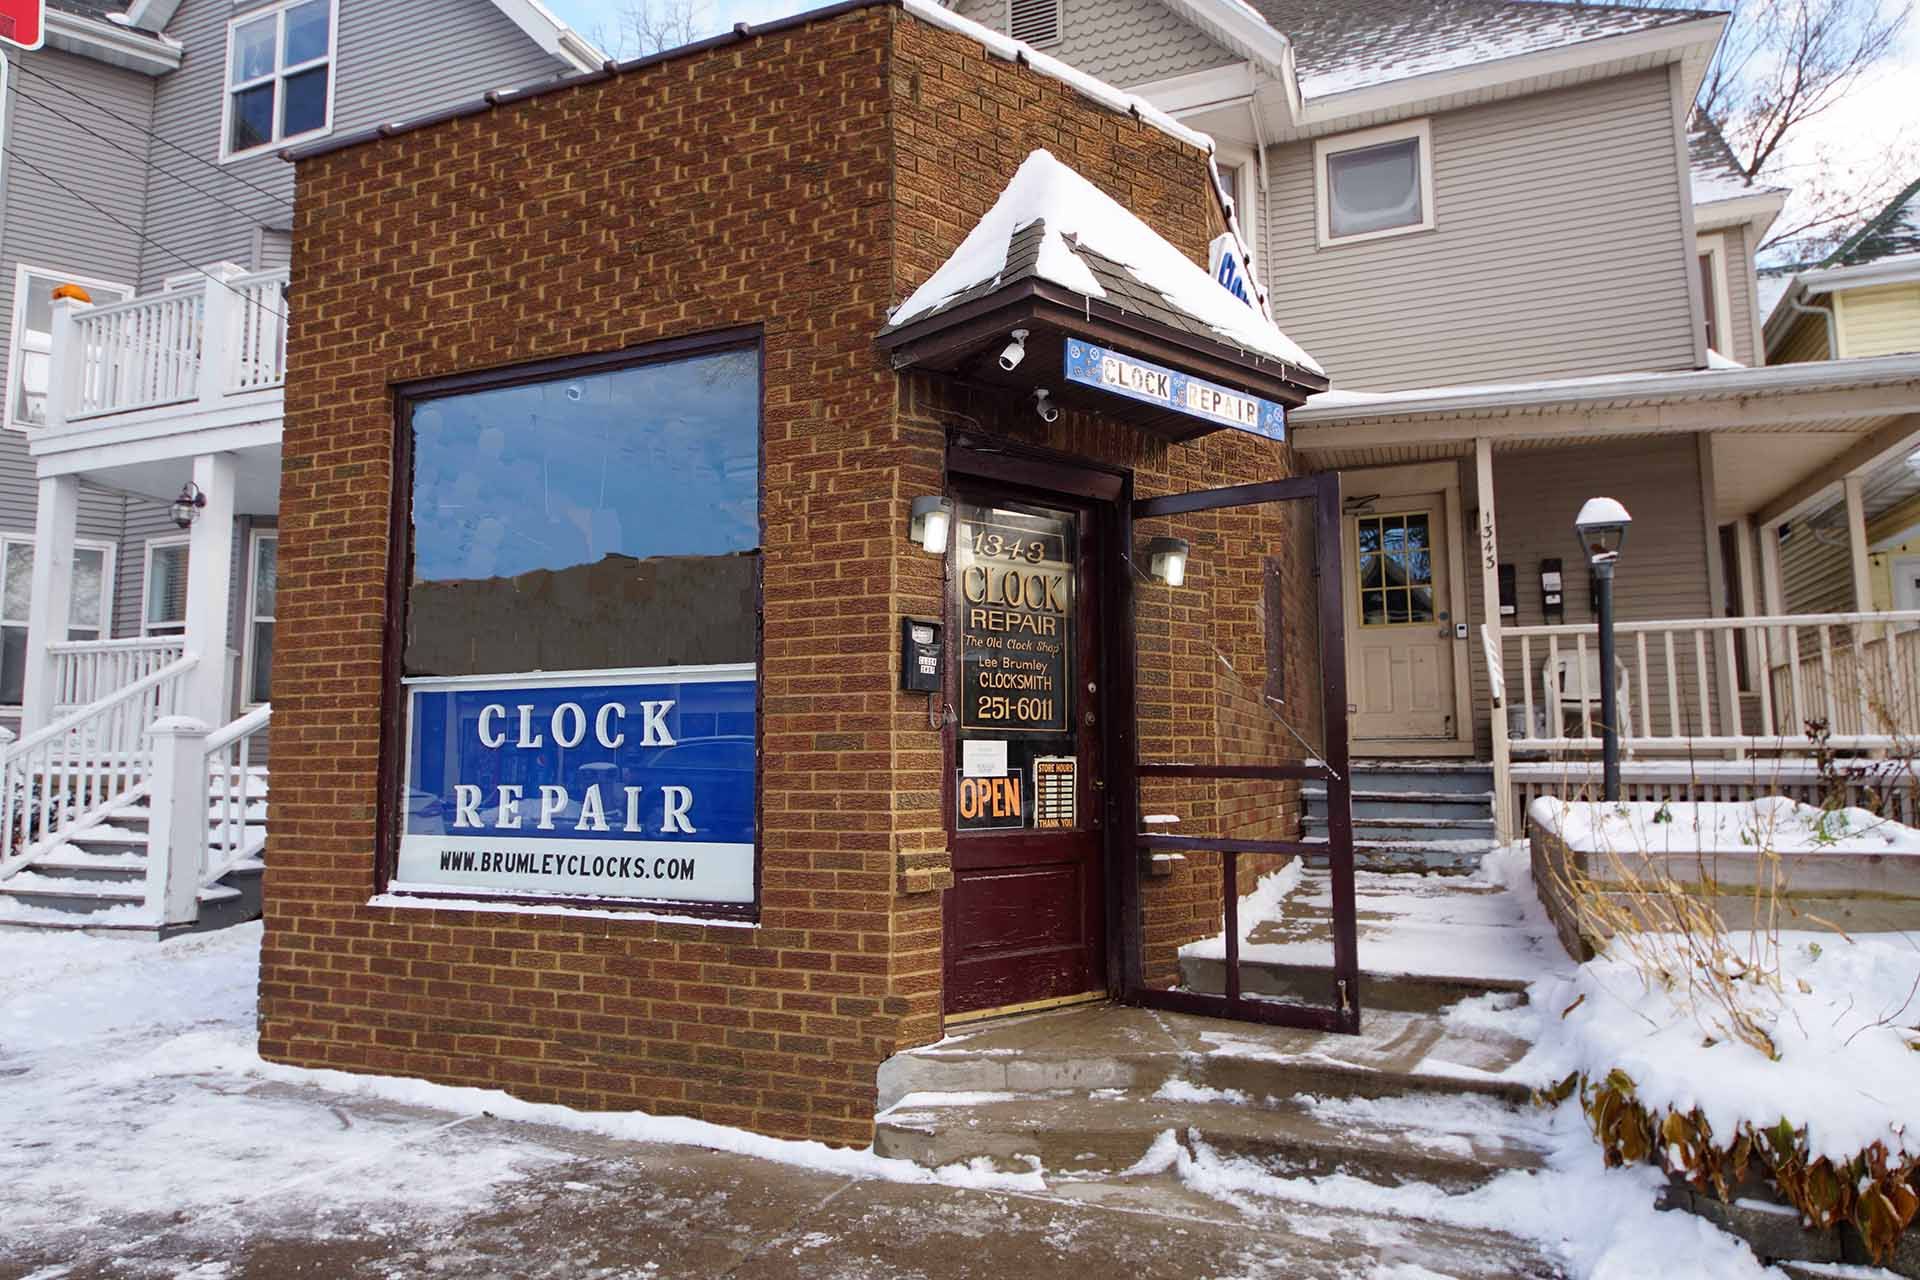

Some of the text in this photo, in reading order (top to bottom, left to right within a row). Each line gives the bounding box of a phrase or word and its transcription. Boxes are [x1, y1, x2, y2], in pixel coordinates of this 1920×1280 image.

[1104, 359, 1257, 424] CLOCK REPAIR
[973, 531, 1046, 564] 1343
[1482, 511, 1495, 569] 1343
[963, 566, 1065, 613] CLOCK
[970, 608, 1057, 637] REPAIR
[964, 634, 1060, 658] The Old Clock Shop
[978, 656, 1048, 675] Lee Brumley
[979, 672, 1052, 691] CLOCKSMITH
[477, 700, 677, 748] CLOCK
[978, 695, 1053, 721] 251-6011
[453, 783, 697, 834] REPAIR
[959, 778, 1021, 819] OPEN
[440, 850, 695, 881] WWW.BRUMLEYCLOCKS.COM
